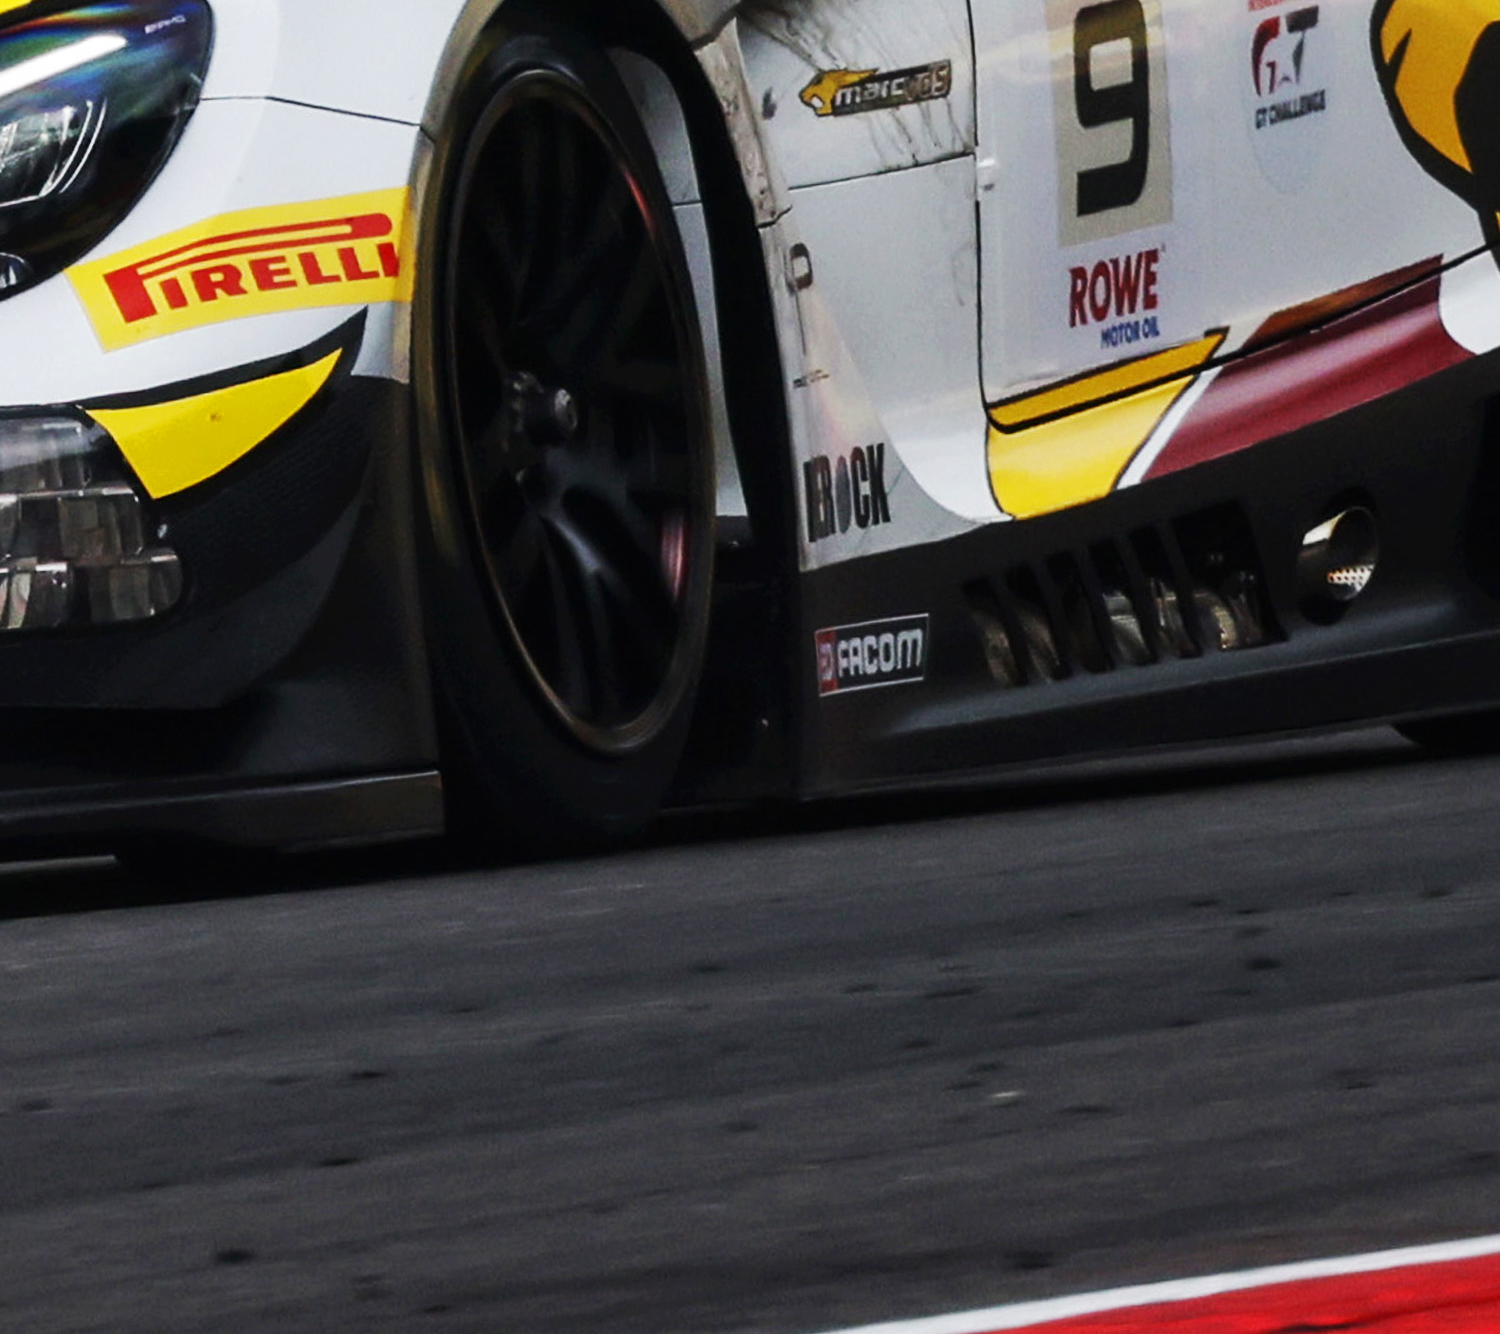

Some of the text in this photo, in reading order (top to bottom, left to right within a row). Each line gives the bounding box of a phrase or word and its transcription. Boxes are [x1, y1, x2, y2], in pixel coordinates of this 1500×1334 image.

[103, 212, 400, 323] PIRELLI
[1068, 248, 1160, 328] ROWE
[1101, 315, 1160, 348] MOTOR OIL
[837, 628, 924, 678] FACOM
